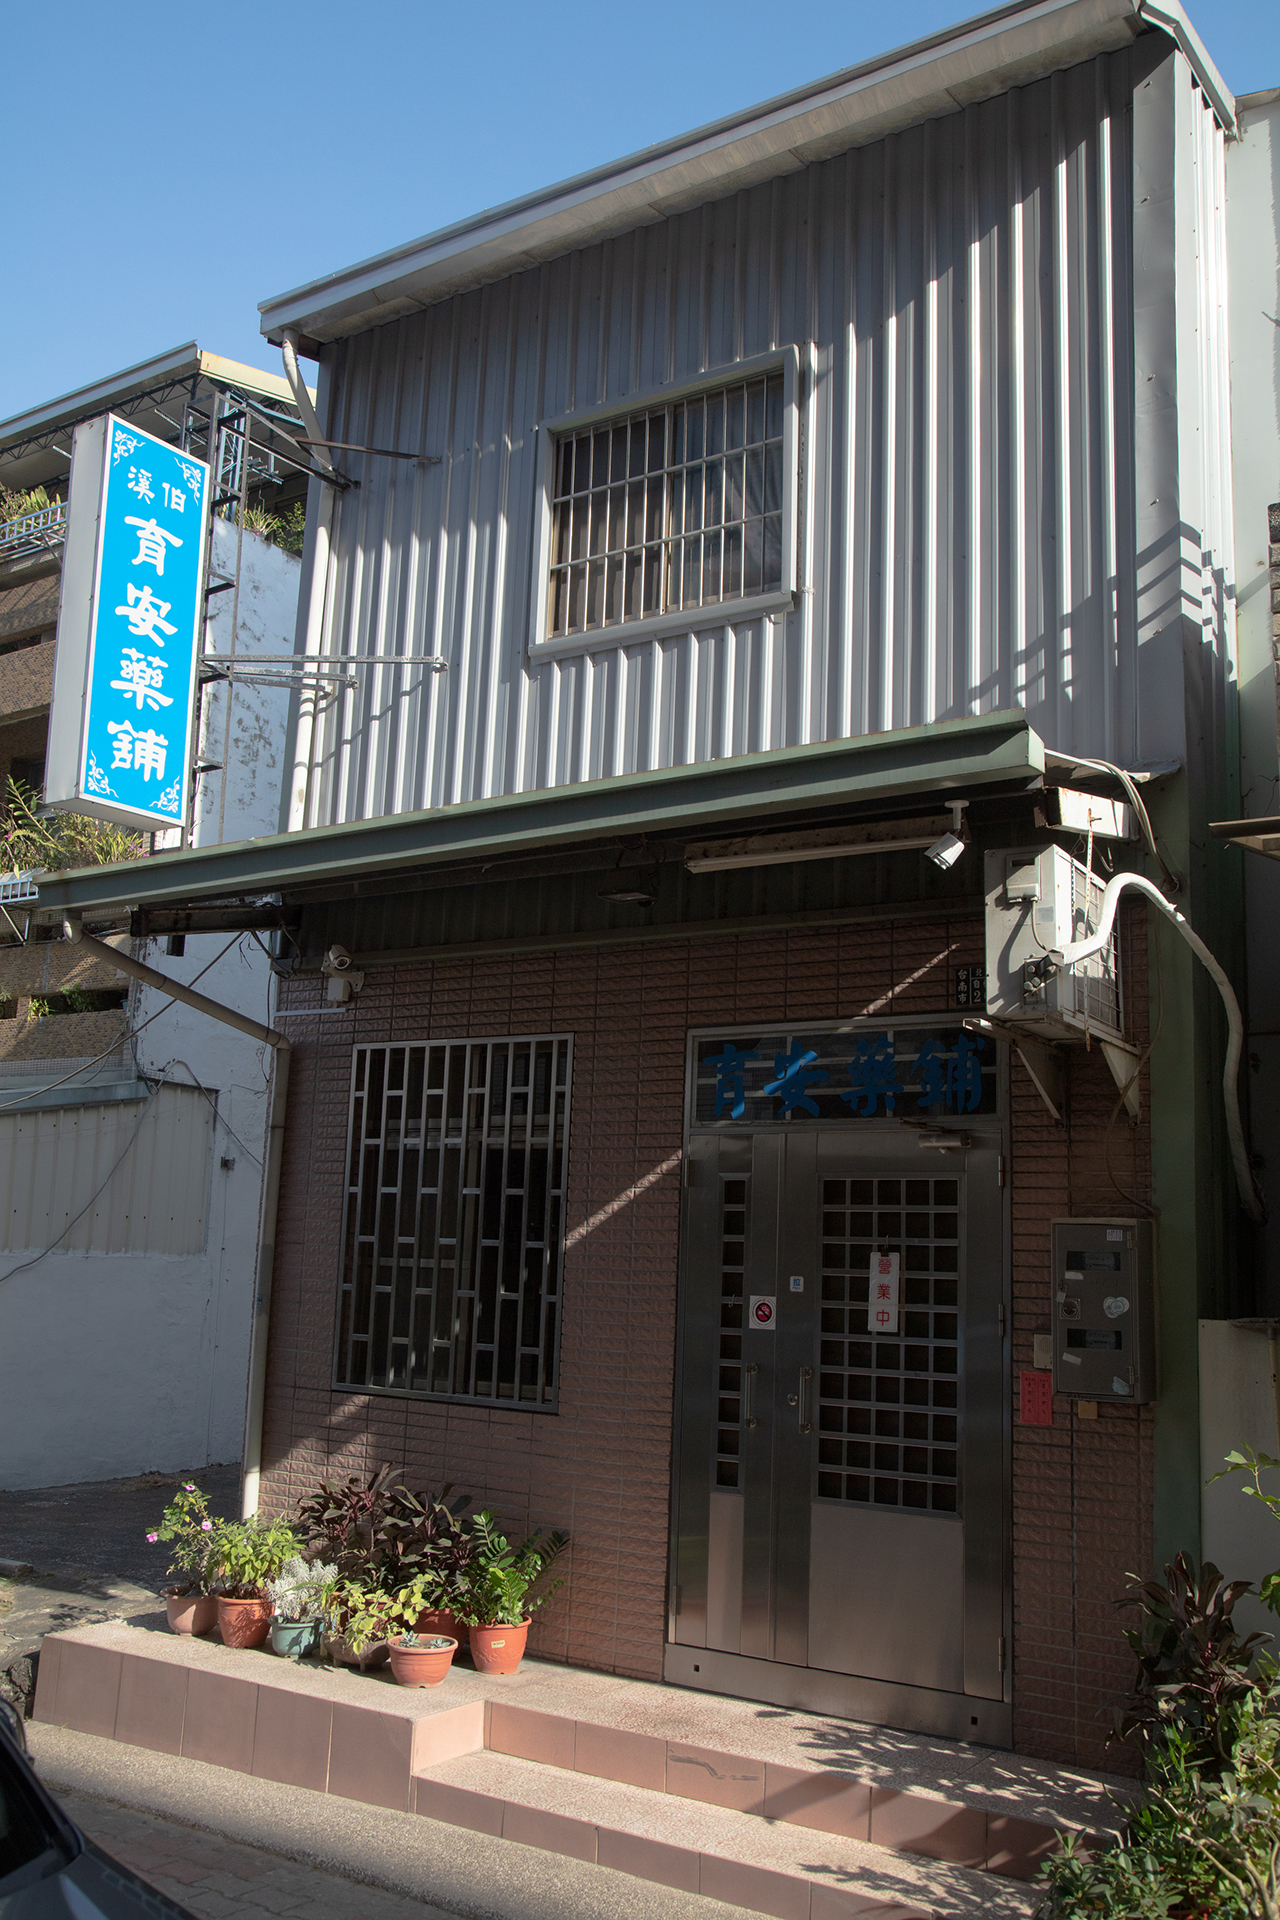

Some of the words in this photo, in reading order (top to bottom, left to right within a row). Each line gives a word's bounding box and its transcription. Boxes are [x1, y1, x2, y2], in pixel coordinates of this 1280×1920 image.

[957, 969, 968, 1003] 台南市
[876, 1257, 892, 1327] 營業中
